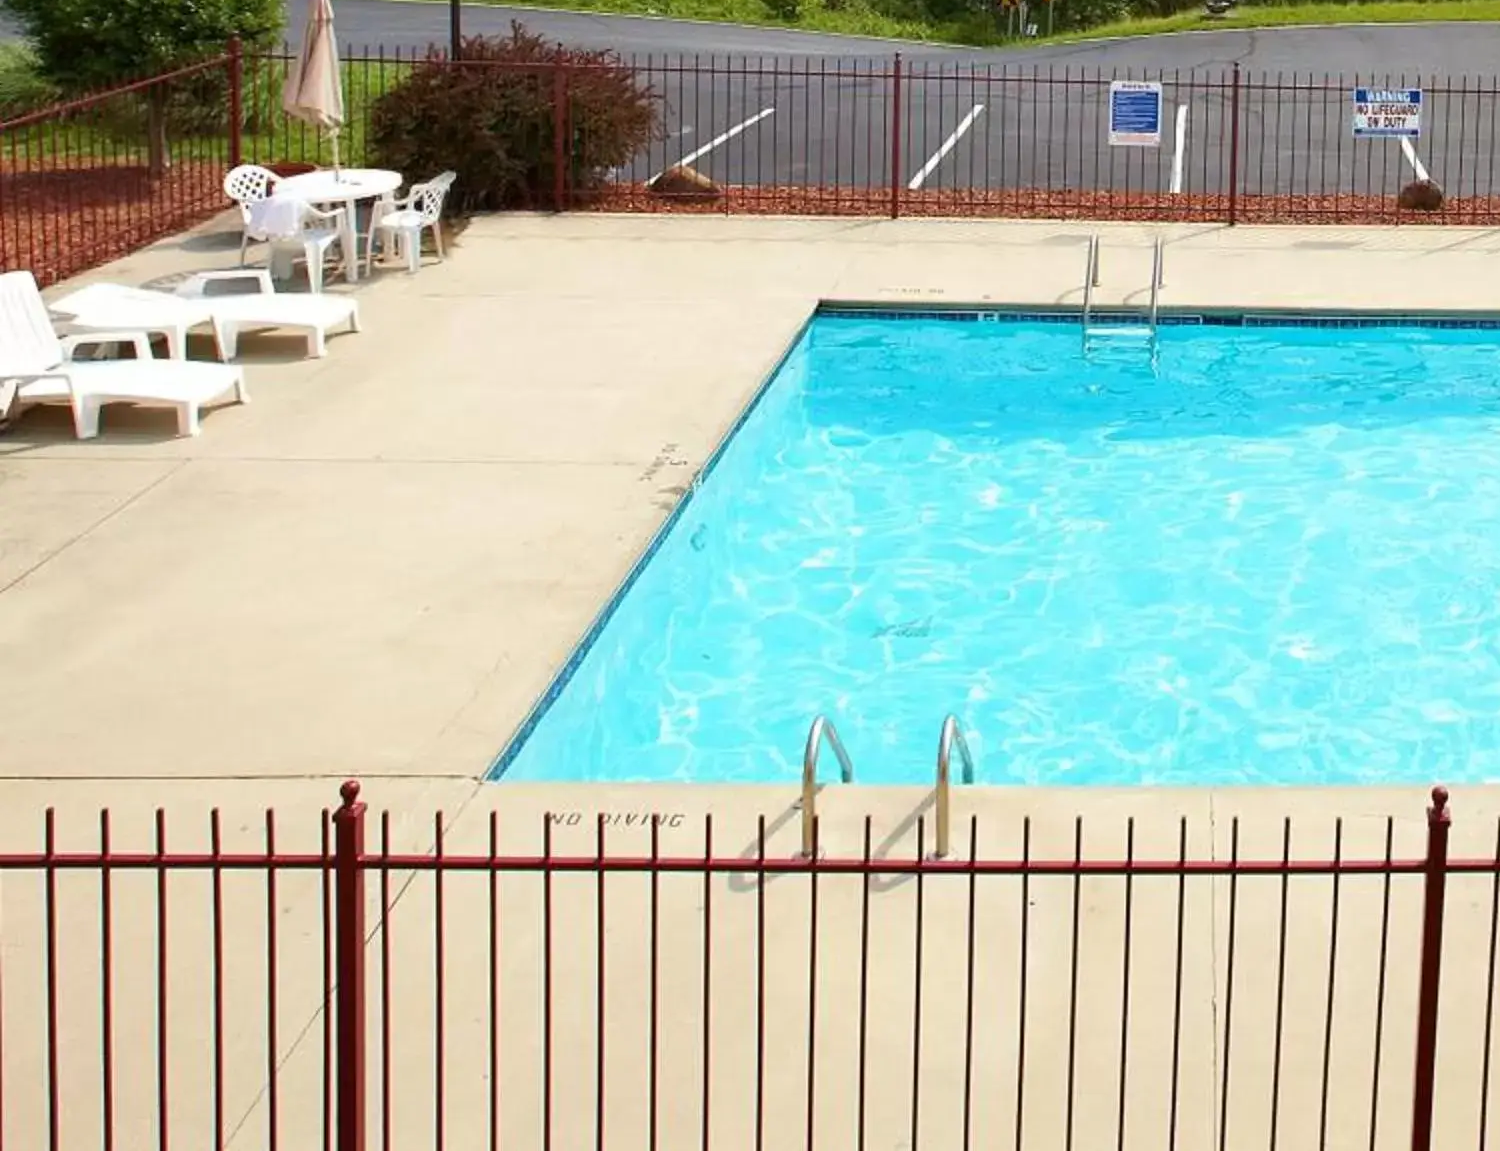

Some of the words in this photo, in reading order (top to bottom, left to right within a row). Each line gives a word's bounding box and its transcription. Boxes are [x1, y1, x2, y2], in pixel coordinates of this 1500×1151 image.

[1366, 90, 1411, 102] WARNING
[1357, 104, 1368, 115] NO
[1372, 104, 1417, 116] LIFEGUARD
[1368, 116, 1379, 127] ON
[1384, 116, 1407, 128] DUTY
[548, 812, 582, 826] NO
[599, 812, 686, 828] DIVING
